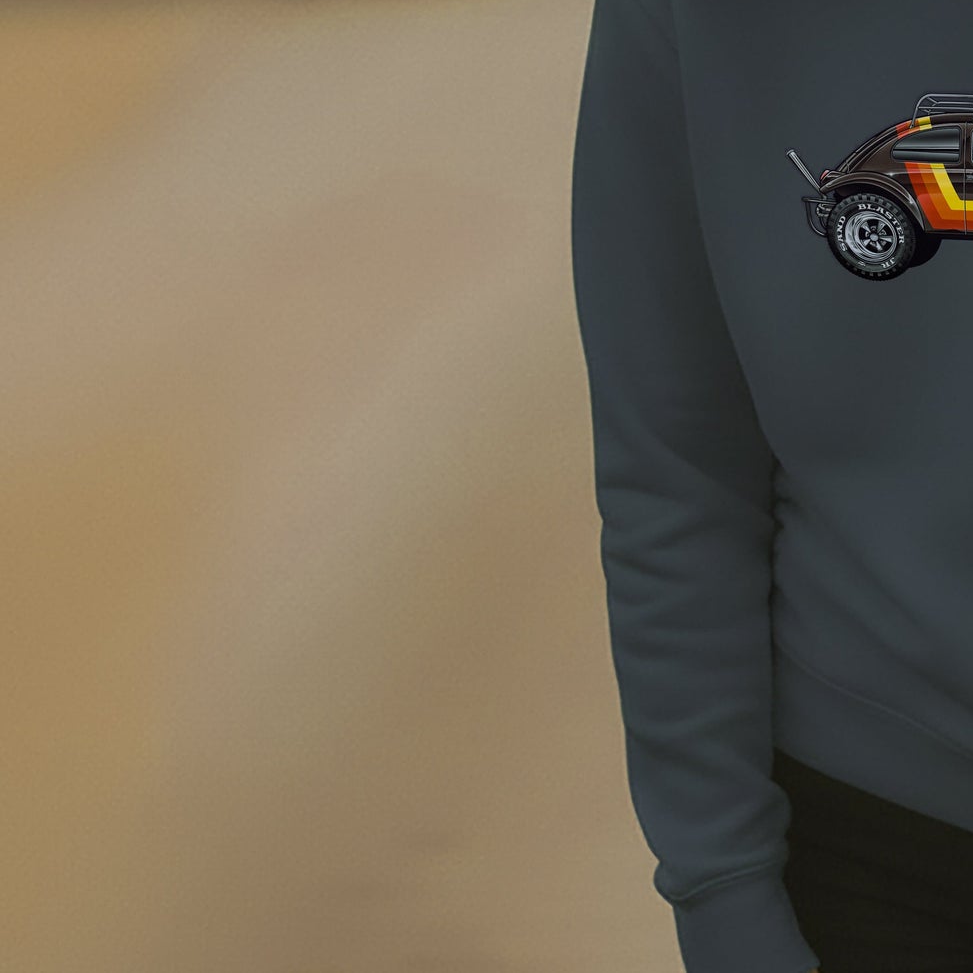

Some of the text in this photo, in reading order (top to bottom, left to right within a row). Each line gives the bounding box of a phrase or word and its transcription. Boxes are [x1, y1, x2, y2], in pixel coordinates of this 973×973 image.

[836, 203, 905, 269] SAND BLASTER JR
